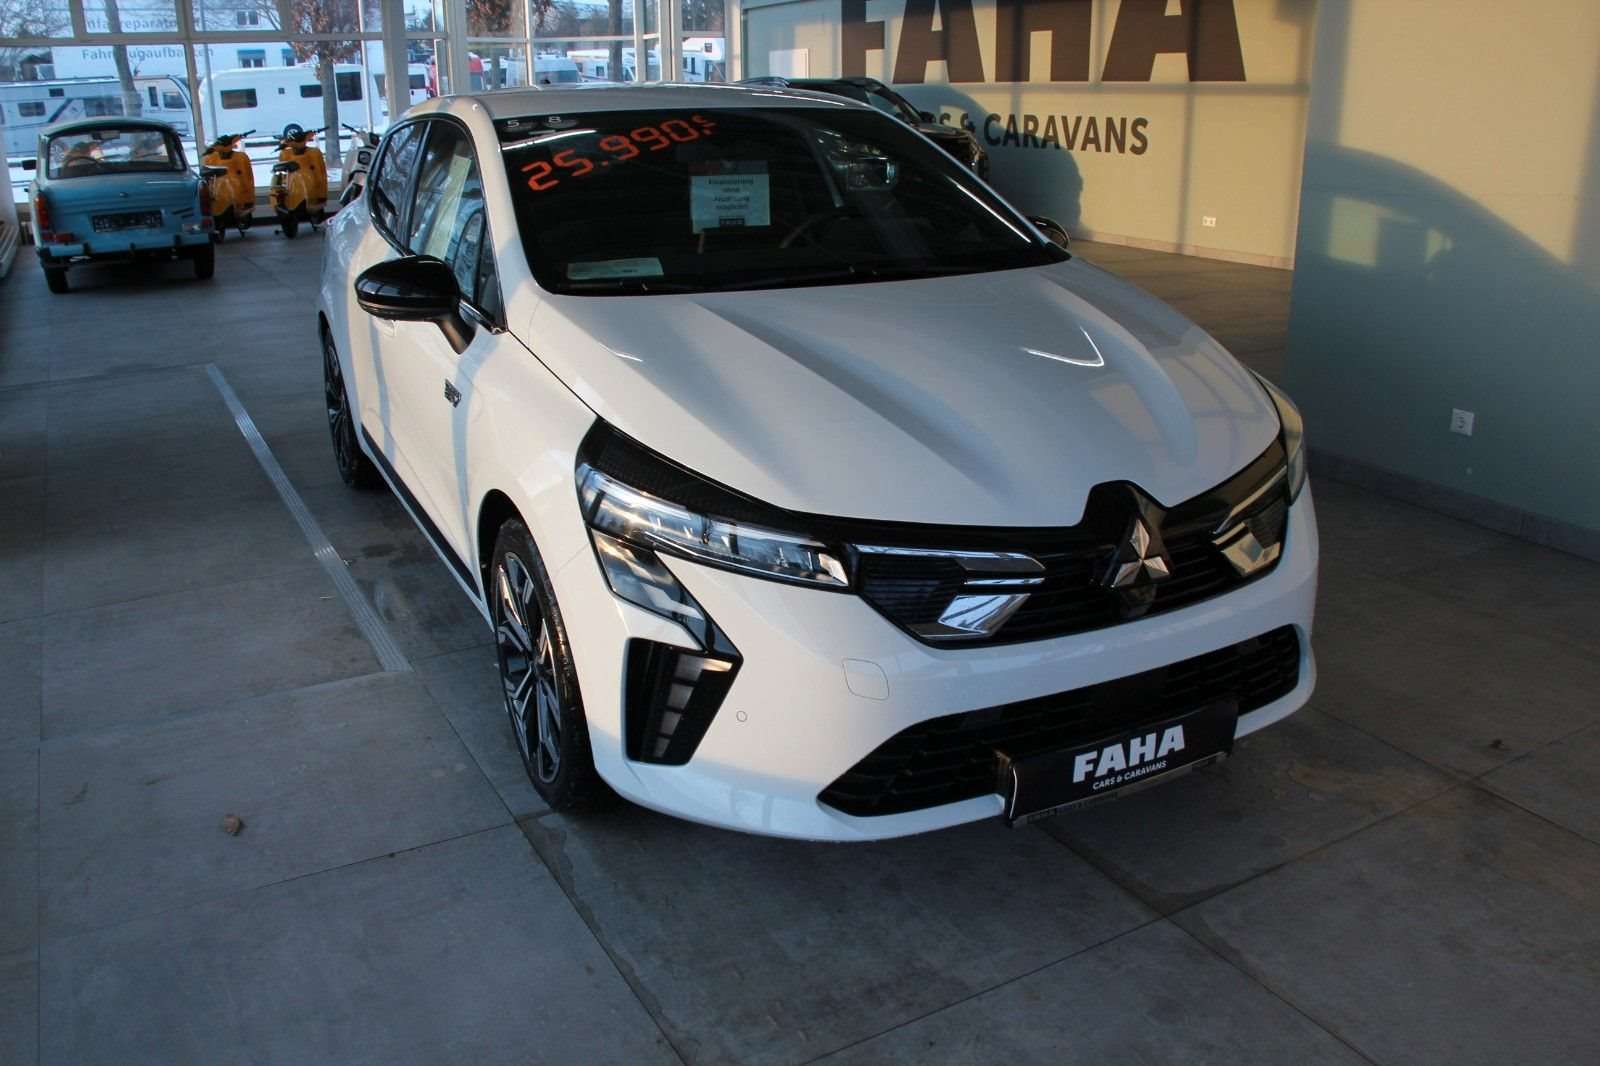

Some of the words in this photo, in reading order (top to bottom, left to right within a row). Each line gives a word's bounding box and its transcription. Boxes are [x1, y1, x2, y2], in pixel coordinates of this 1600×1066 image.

[841, 0, 1246, 82] FAHA
[984, 113, 1149, 155] CARAVANS
[1072, 724, 1185, 783] FAHA
[1092, 776, 1115, 790] CARS
[1116, 774, 1123, 783] &
[1124, 760, 1167, 780] CARAVANS
